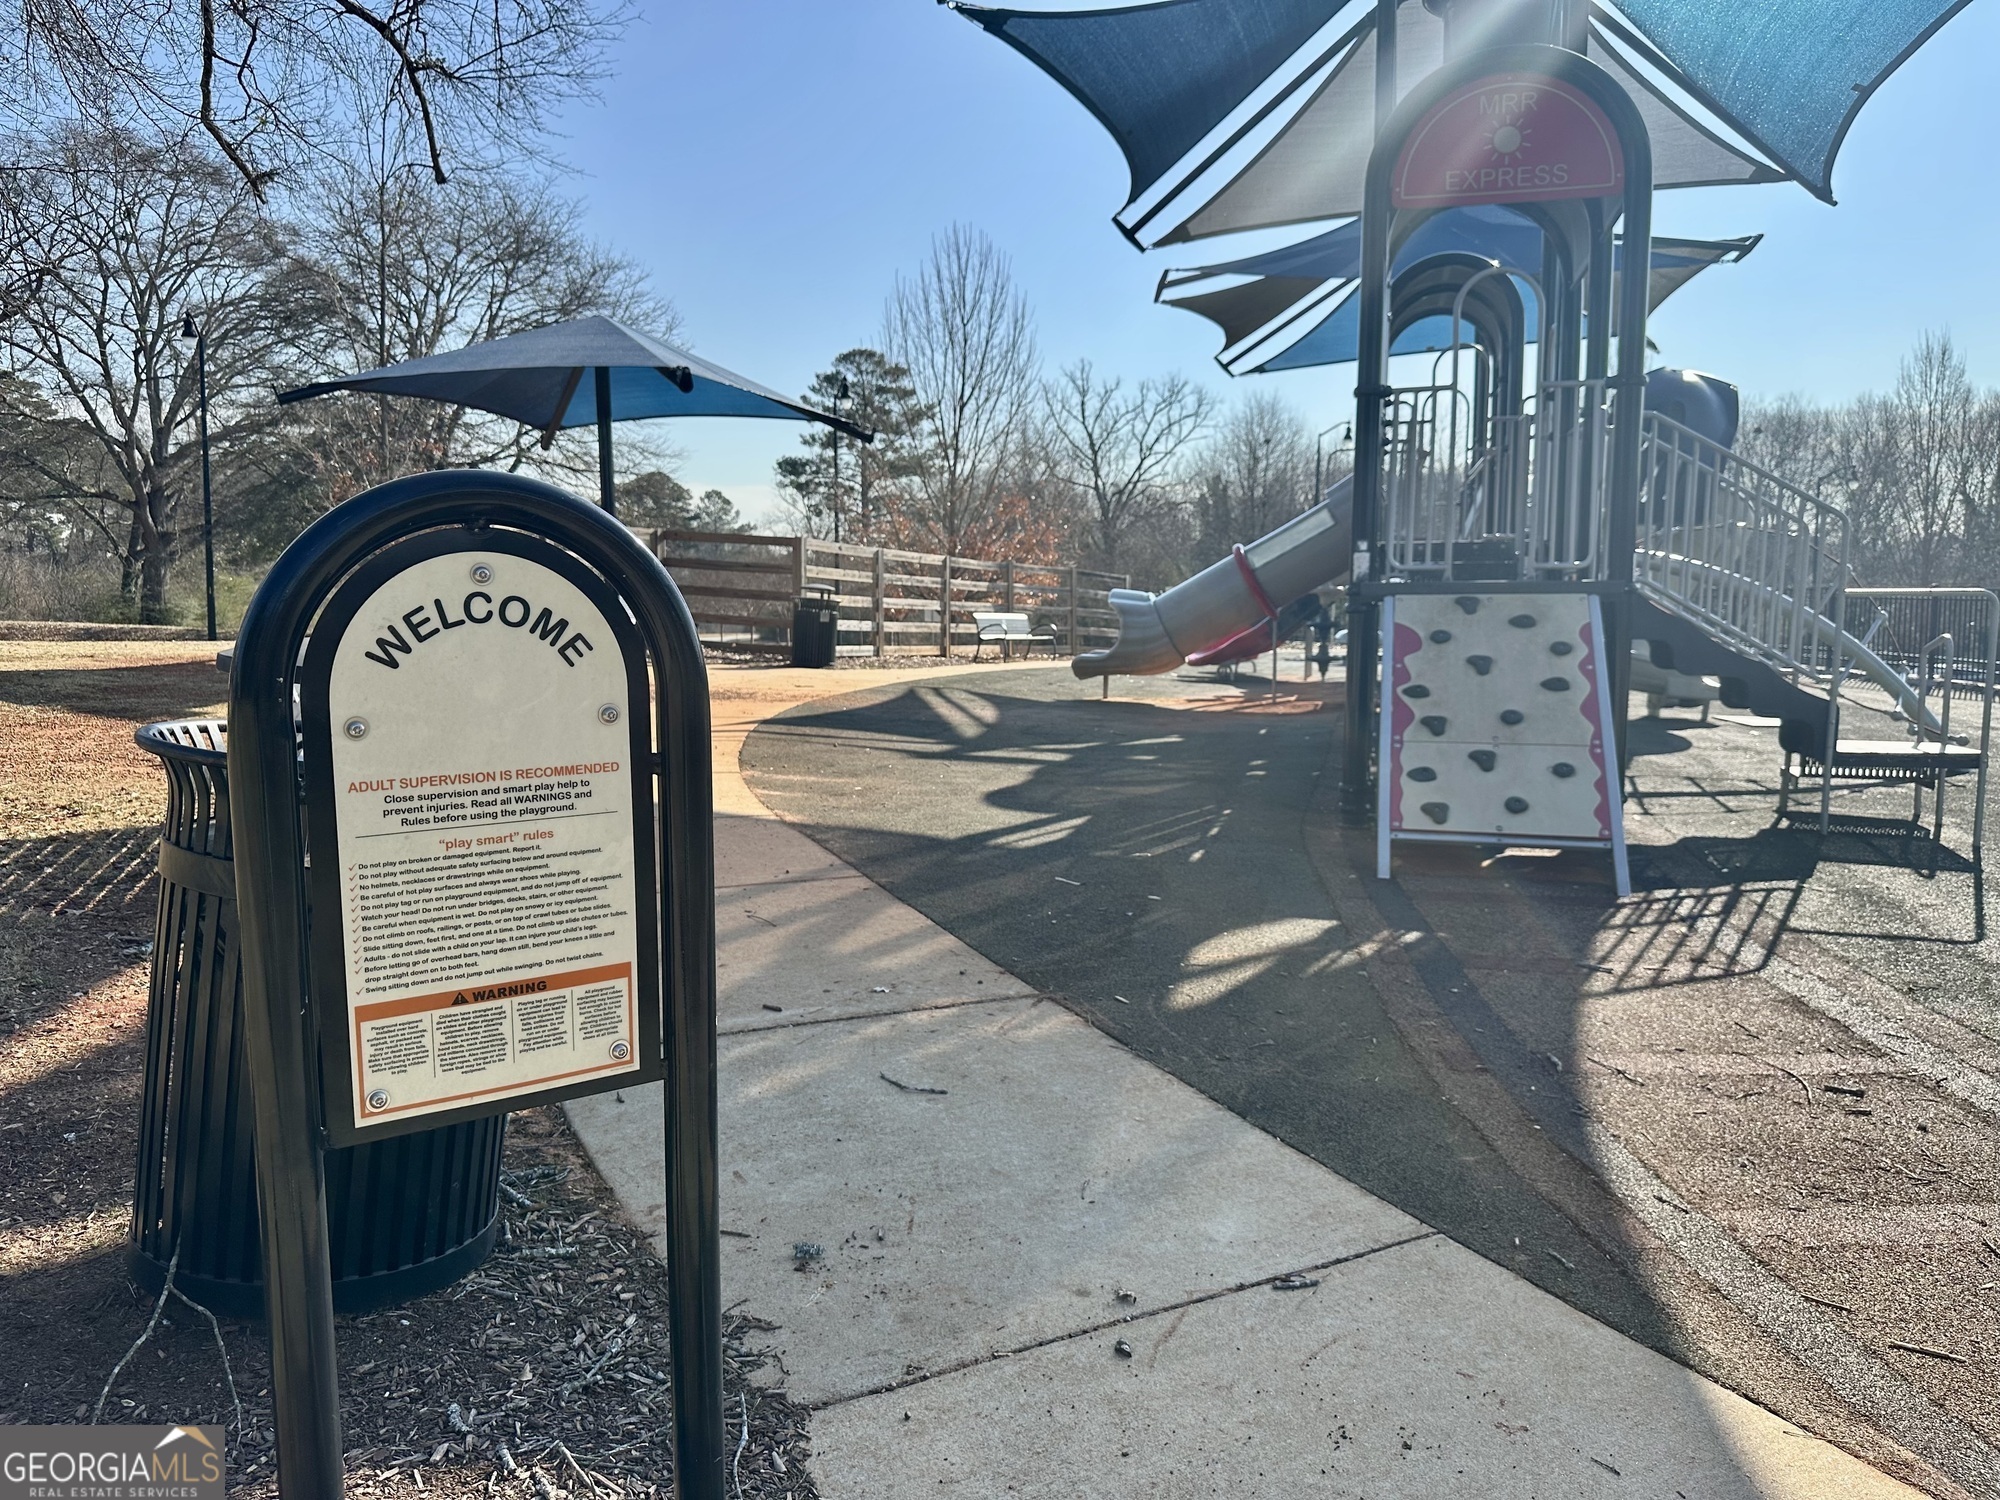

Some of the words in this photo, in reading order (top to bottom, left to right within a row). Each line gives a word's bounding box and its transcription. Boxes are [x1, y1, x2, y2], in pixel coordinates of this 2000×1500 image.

[1480, 92, 1537, 115] MRR
[1446, 165, 1568, 191] EXPRESS
[365, 591, 594, 669] WELCOME
[348, 779, 396, 793] ADULT
[399, 771, 496, 789] SUPERVISION
[500, 770, 512, 781] IS
[516, 762, 619, 780] RECOMMENDED
[384, 795, 414, 804] Close
[417, 789, 478, 802] supervision
[481, 786, 500, 796] and
[503, 784, 532, 794] smart
[535, 783, 555, 793] play
[557, 780, 578, 789] help
[580, 779, 590, 787] to
[383, 805, 424, 818] prevent
[426, 802, 468, 814] injuries.
[471, 798, 497, 808] Read
[500, 797, 512, 805] all
[514, 791, 572, 804] WARNINGS
[574, 790, 592, 799] and
[401, 817, 430, 826] Rules
[433, 814, 467, 823] before
[470, 811, 498, 820] using
[500, 809, 517, 817] the
[519, 802, 577, 817] playground.
[523, 830, 554, 841] rules
[399, 867, 424, 875] without
[425, 864, 457, 872] adequate
[546, 851, 568, 859] around
[442, 852, 473, 860] damaged
[512, 845, 534, 853] Report
[402, 877, 436, 885] necklaces
[446, 871, 486, 880] drawstrings
[371, 891, 395, 900] careful
[418, 887, 432, 895] play
[434, 884, 463, 892] surfaces
[445, 891, 482, 902] playground
[373, 922, 397, 930] careful
[418, 914, 454, 924] equipment
[384, 912, 400, 920] your
[386, 931, 405, 939] climb
[533, 911, 550, 919] crawl
[388, 982, 409, 990] sitting
[466, 971, 483, 979] jump
[472, 980, 548, 1002] WARNING
